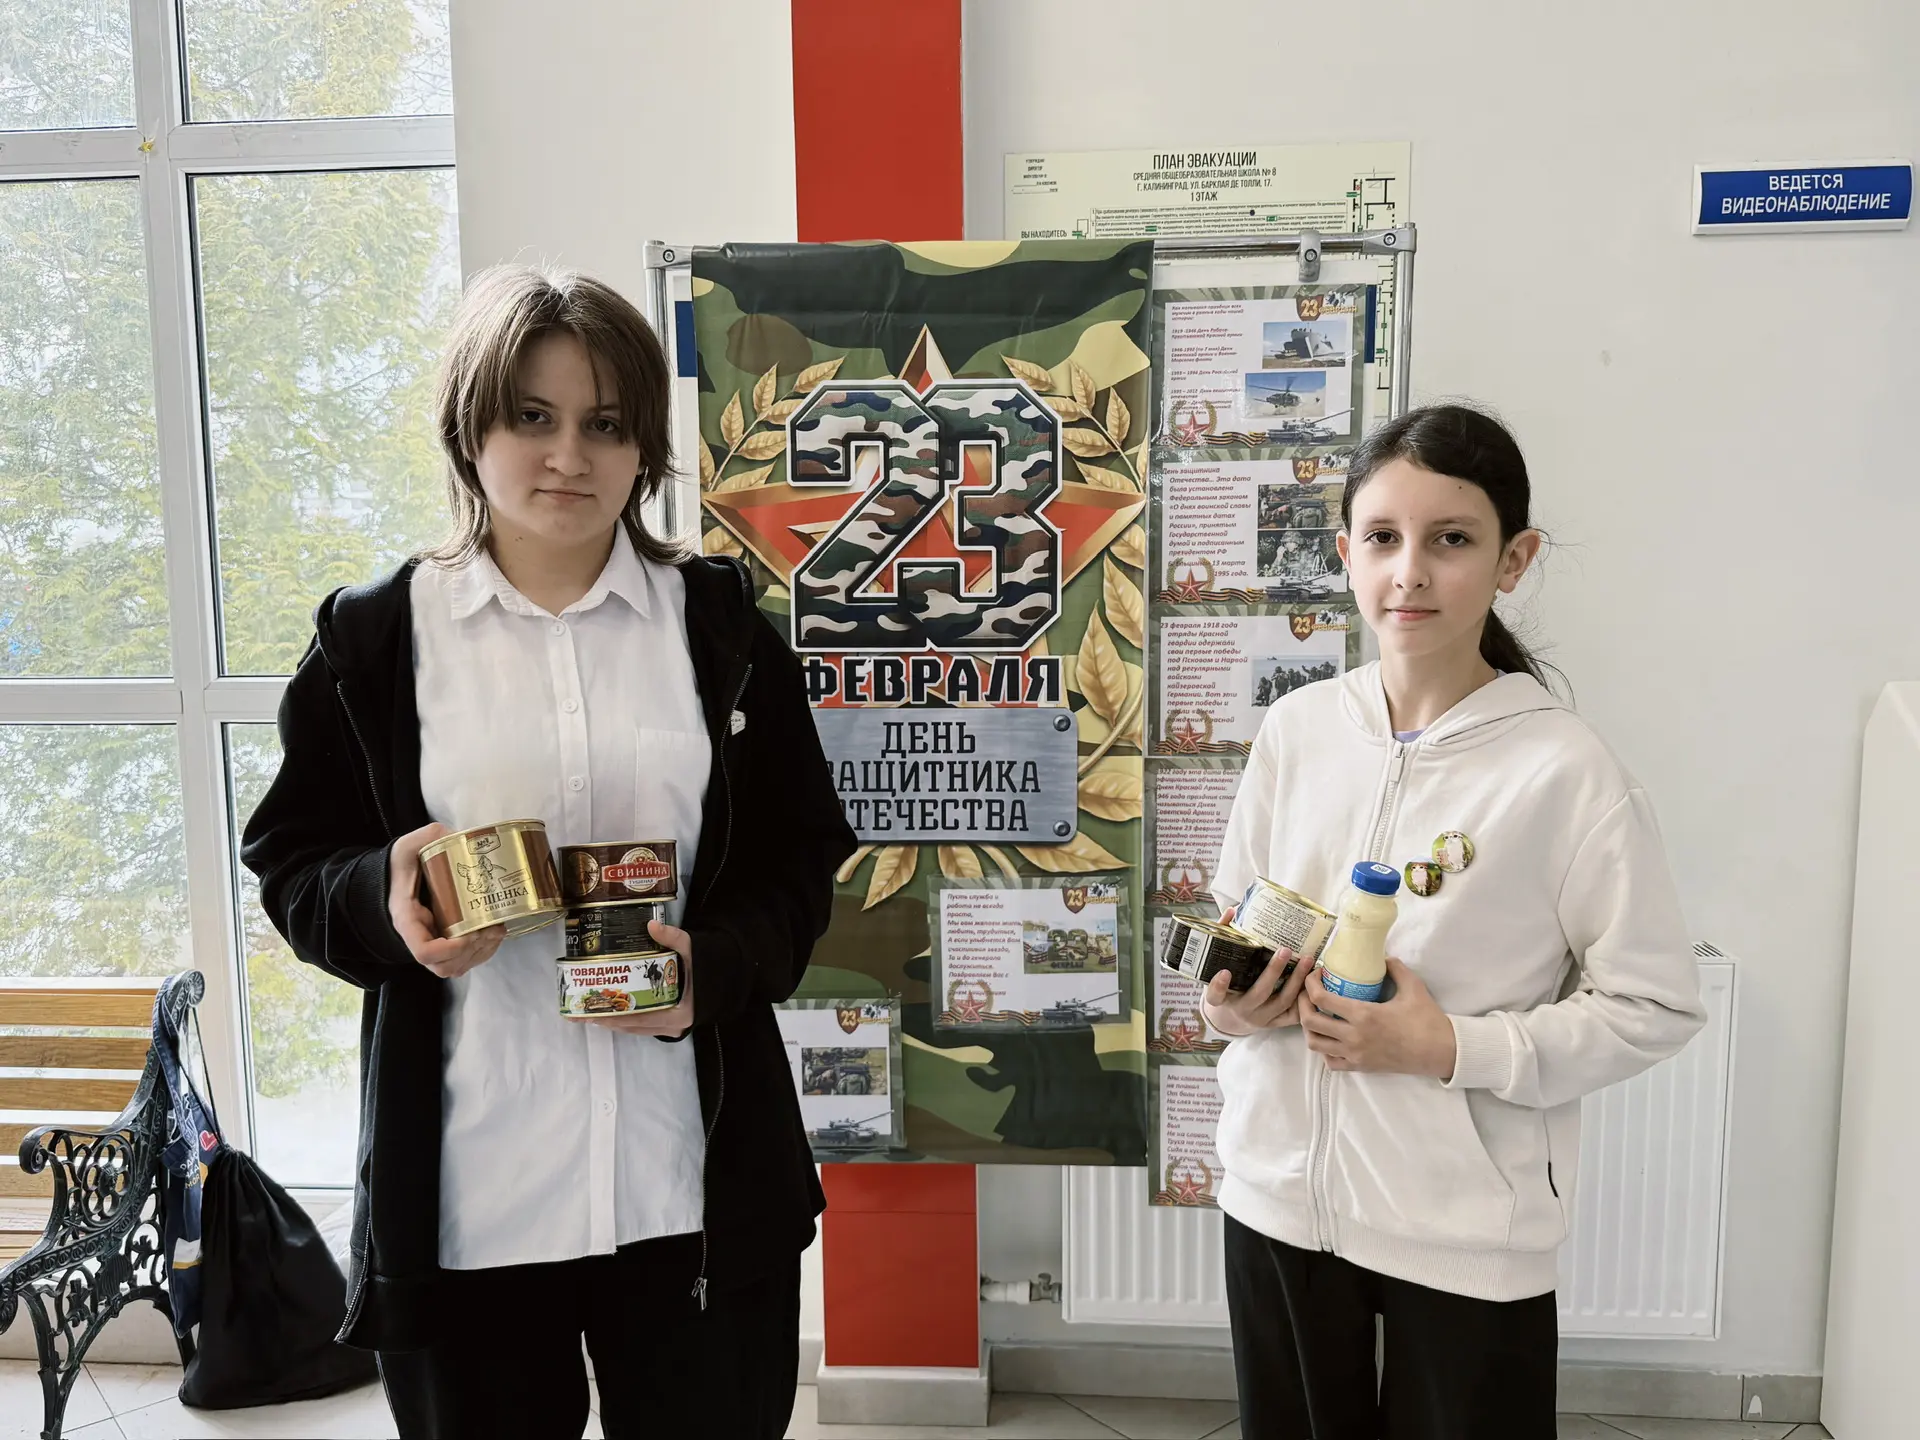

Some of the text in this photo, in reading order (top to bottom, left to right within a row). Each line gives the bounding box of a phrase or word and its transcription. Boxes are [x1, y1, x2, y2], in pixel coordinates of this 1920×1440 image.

[1153, 152, 1256, 169] ПЛАН ЭВАКУАЦИИ
[1133, 172, 1161, 180] СРЕДНЯЯ
[1162, 170, 1237, 180] ОБЩЕОБРАЗОВАТЕЛЬНАЯ
[1238, 169, 1260, 177] ШКОЛА
[1262, 169, 1271, 177] №
[1201, 180, 1229, 188] БАРКЛАЯ
[1231, 180, 1239, 188] ДЕ
[1769, 174, 1843, 192] ВЕДЕТСЯ
[1195, 191, 1217, 202] ЭТАЖ
[1721, 194, 1891, 216] ВИДЕОНАБЛЮДЕНИЕ
[1031, 230, 1067, 238] НАХОДИТЕСЬ
[785, 379, 1063, 652] 23
[802, 656, 1061, 704] ФЕВРАЛЯ
[880, 721, 976, 758] ДЕНЬ
[840, 799, 1030, 832] ТЕЧЕСТВА
[608, 866, 668, 878] СВИНИНА
[468, 887, 529, 910] ТУШЕНКА
[485, 899, 516, 911] свиная
[571, 965, 631, 976] ГОВЯДИНА
[573, 975, 629, 987] ТУШЕНАЯ
